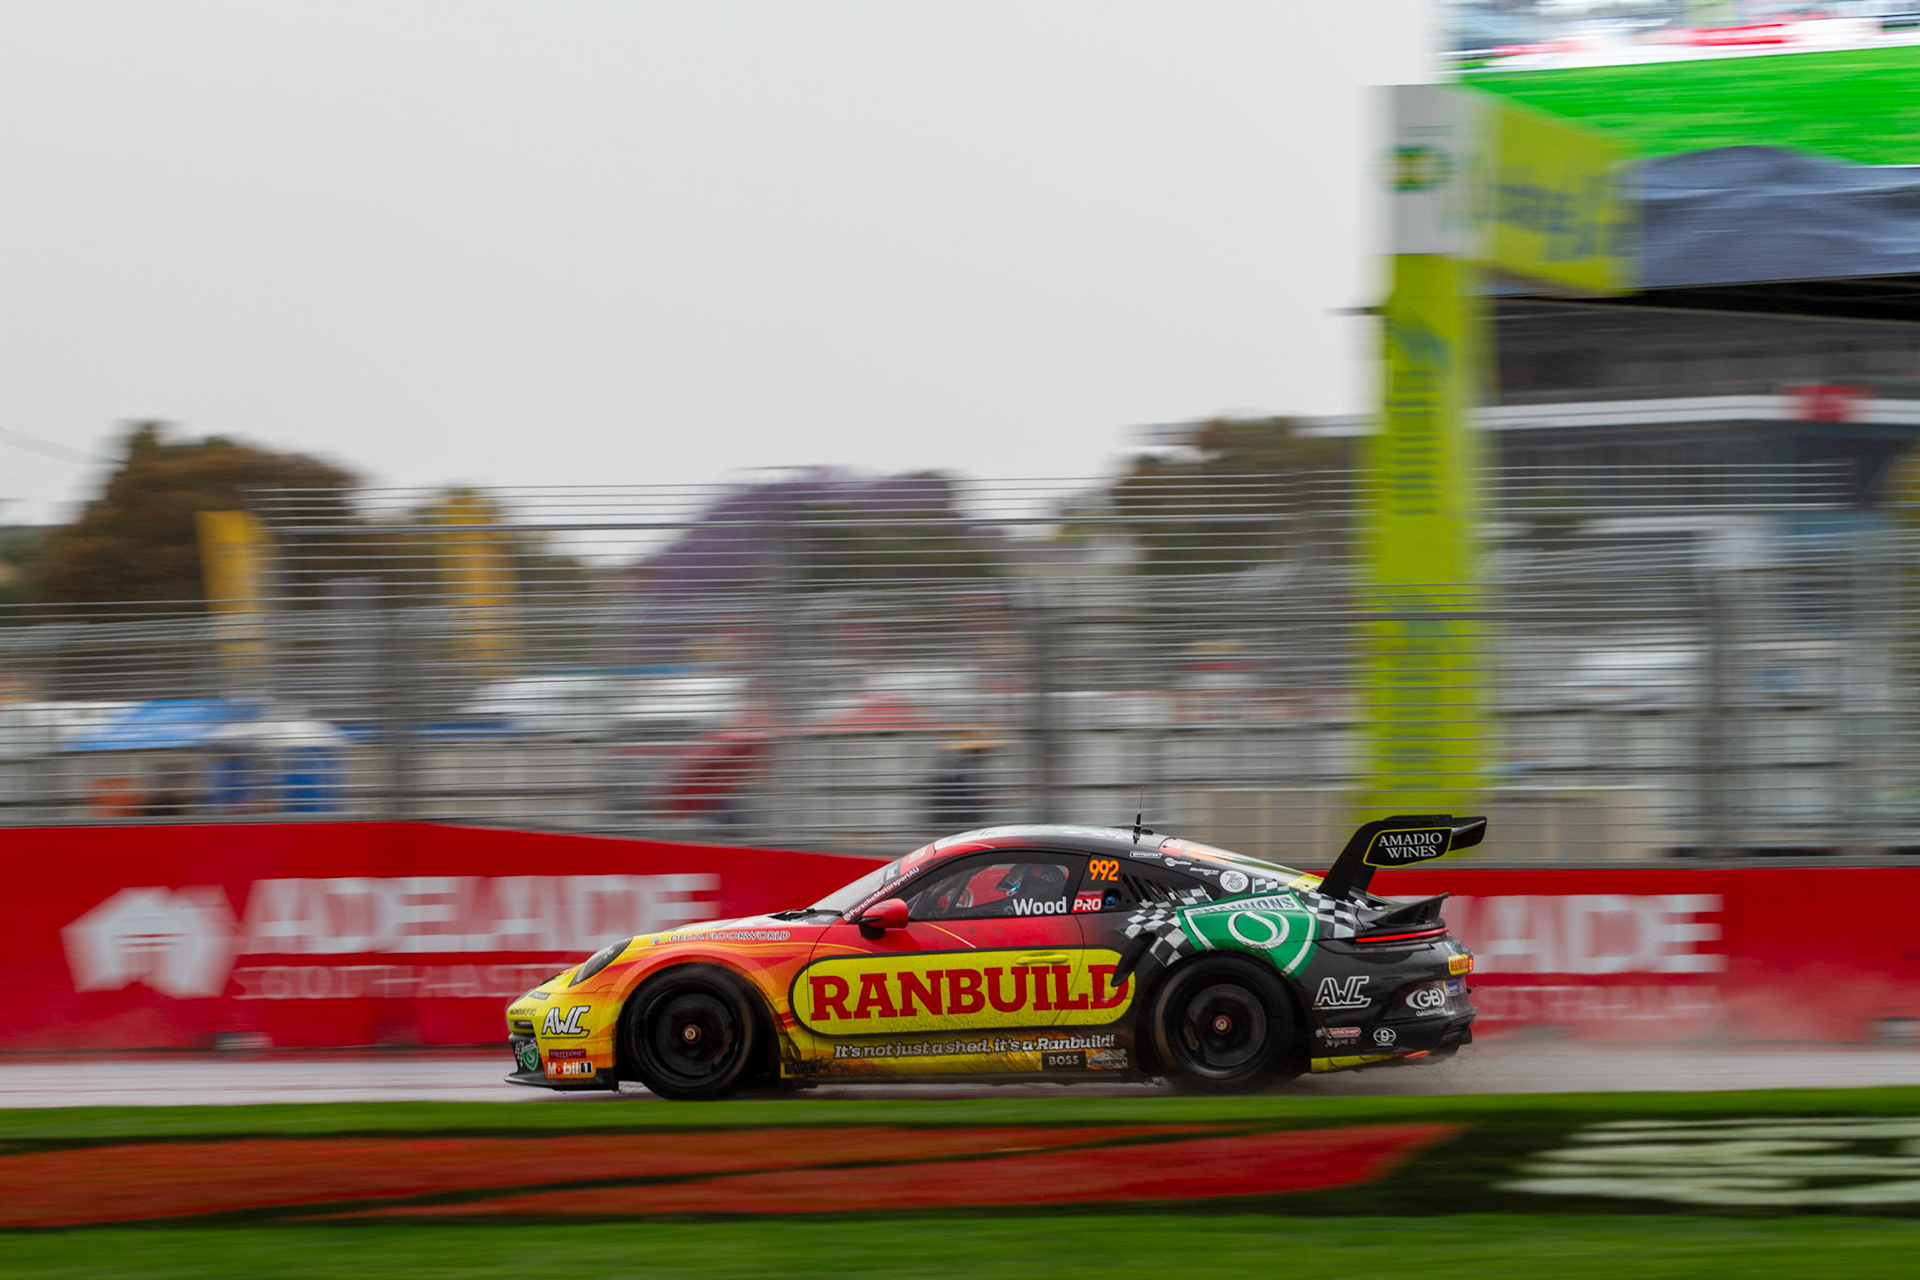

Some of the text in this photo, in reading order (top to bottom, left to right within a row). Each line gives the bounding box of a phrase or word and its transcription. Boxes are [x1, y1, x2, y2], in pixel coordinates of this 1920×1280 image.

[1378, 832, 1443, 847] AMADIO
[1385, 845, 1437, 859] WINES
[1089, 859, 1119, 881] 992
[843, 866, 920, 922] @PorscheMotorsportAU
[1012, 896, 1067, 915] Wood
[1073, 898, 1101, 911] PRO
[706, 930, 790, 941] FLOORWORLD
[809, 964, 1130, 1021] RANBUILD
[1313, 975, 1372, 1011] AWC
[1417, 989, 1440, 1007] GB
[541, 1005, 591, 1039] AWC
[834, 1034, 1115, 1058] It's not just a shed, it's a Ranbuild!
[547, 1062, 592, 1075] Mobil 1
[1048, 1055, 1079, 1066] BOSS
